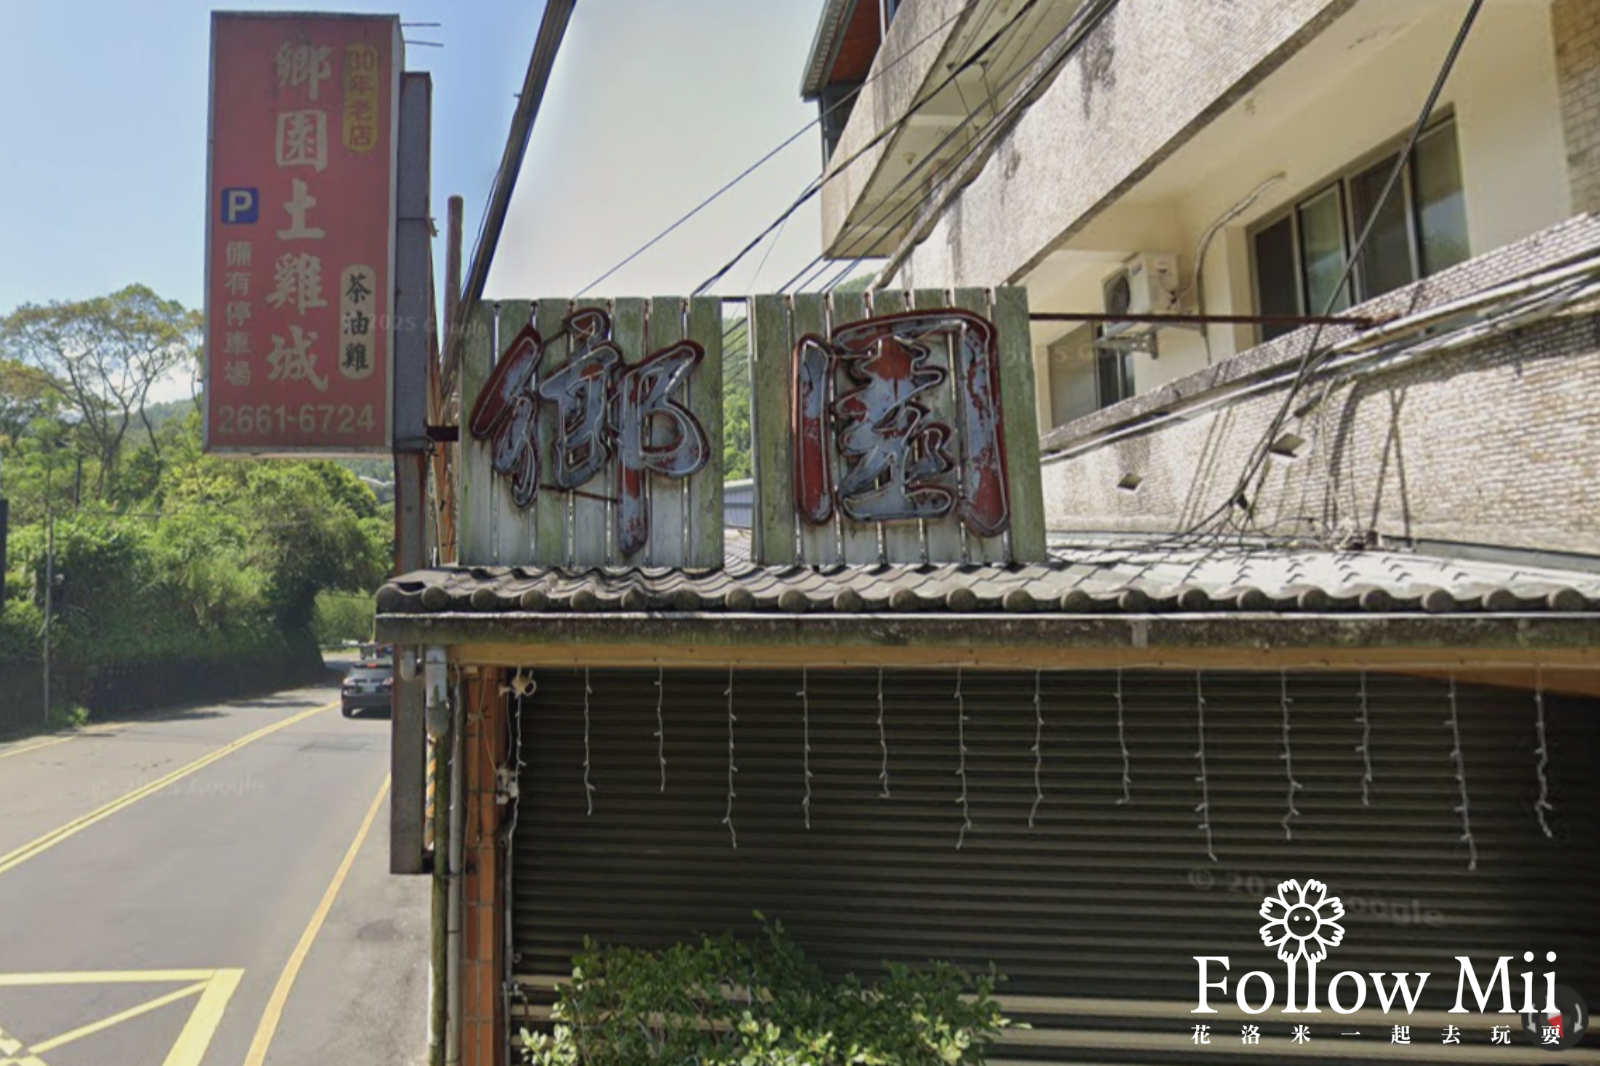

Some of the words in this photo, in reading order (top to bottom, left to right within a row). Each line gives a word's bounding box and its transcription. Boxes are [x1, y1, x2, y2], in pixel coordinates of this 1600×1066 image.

[227, 190, 253, 222] P
[265, 40, 329, 391] 鄉園土雞城
[223, 240, 252, 386] 備有停車場
[341, 273, 372, 373] 茶油雞
[217, 404, 376, 435] 2661-6724
